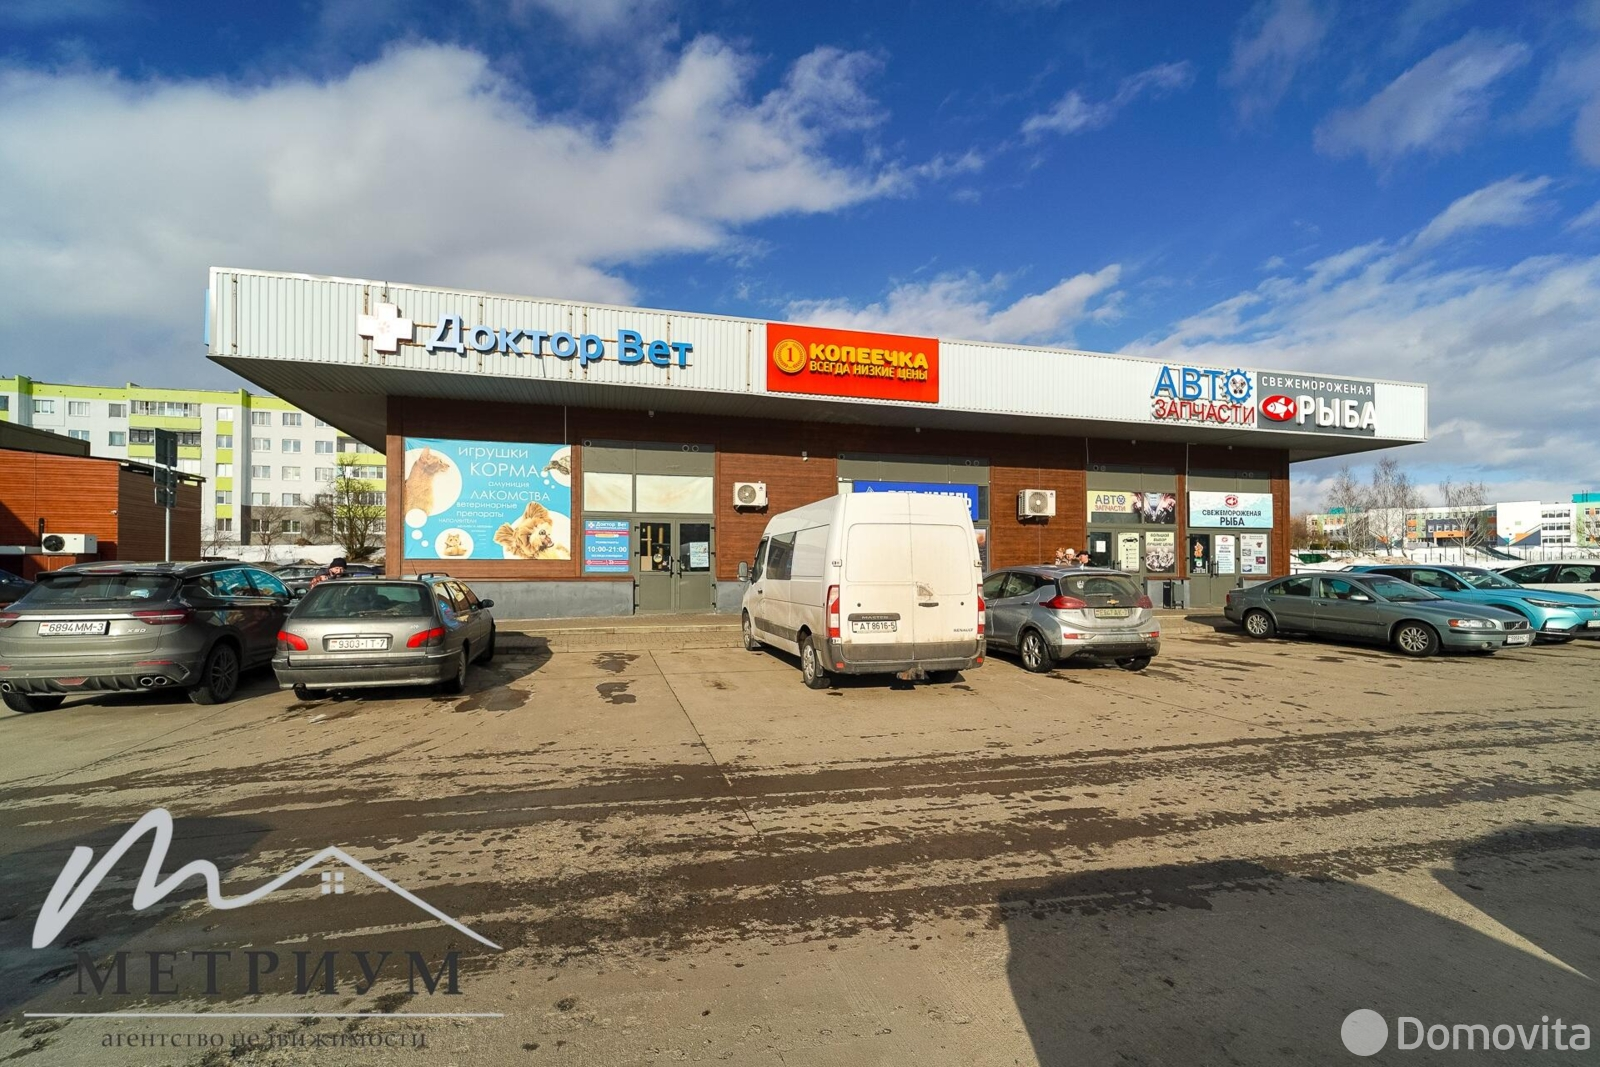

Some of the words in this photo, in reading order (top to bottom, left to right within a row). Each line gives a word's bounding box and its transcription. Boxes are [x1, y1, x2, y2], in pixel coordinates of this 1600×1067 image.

[425, 313, 605, 367] Доктор
[616, 328, 694, 368] Вет
[809, 342, 929, 369] КОПЕЕЧКА
[809, 360, 851, 375] ВСЕГДА
[853, 363, 895, 378] НИЗКИЕ
[896, 367, 928, 380] ЦЕНЫ
[1261, 376, 1372, 396] СВЕЖЕМОРОЖЕНАЯ
[1154, 398, 1255, 424] ЗАПЧАСТИ
[1296, 394, 1377, 432] РЫБА
[458, 446, 529, 460] игрушки
[470, 462, 541, 478] КОРМА
[469, 490, 550, 502] ЛАКОМСТВА
[456, 501, 518, 510] ветеринарные
[1094, 504, 1126, 512] ЗАПЧАСТИ
[456, 510, 504, 518] препараты
[1202, 509, 1262, 517] СВЕЖЕМОРОЖЕНАЯ
[1219, 516, 1245, 526] РЫБА
[587, 545, 628, 553] 10:00-21:00
